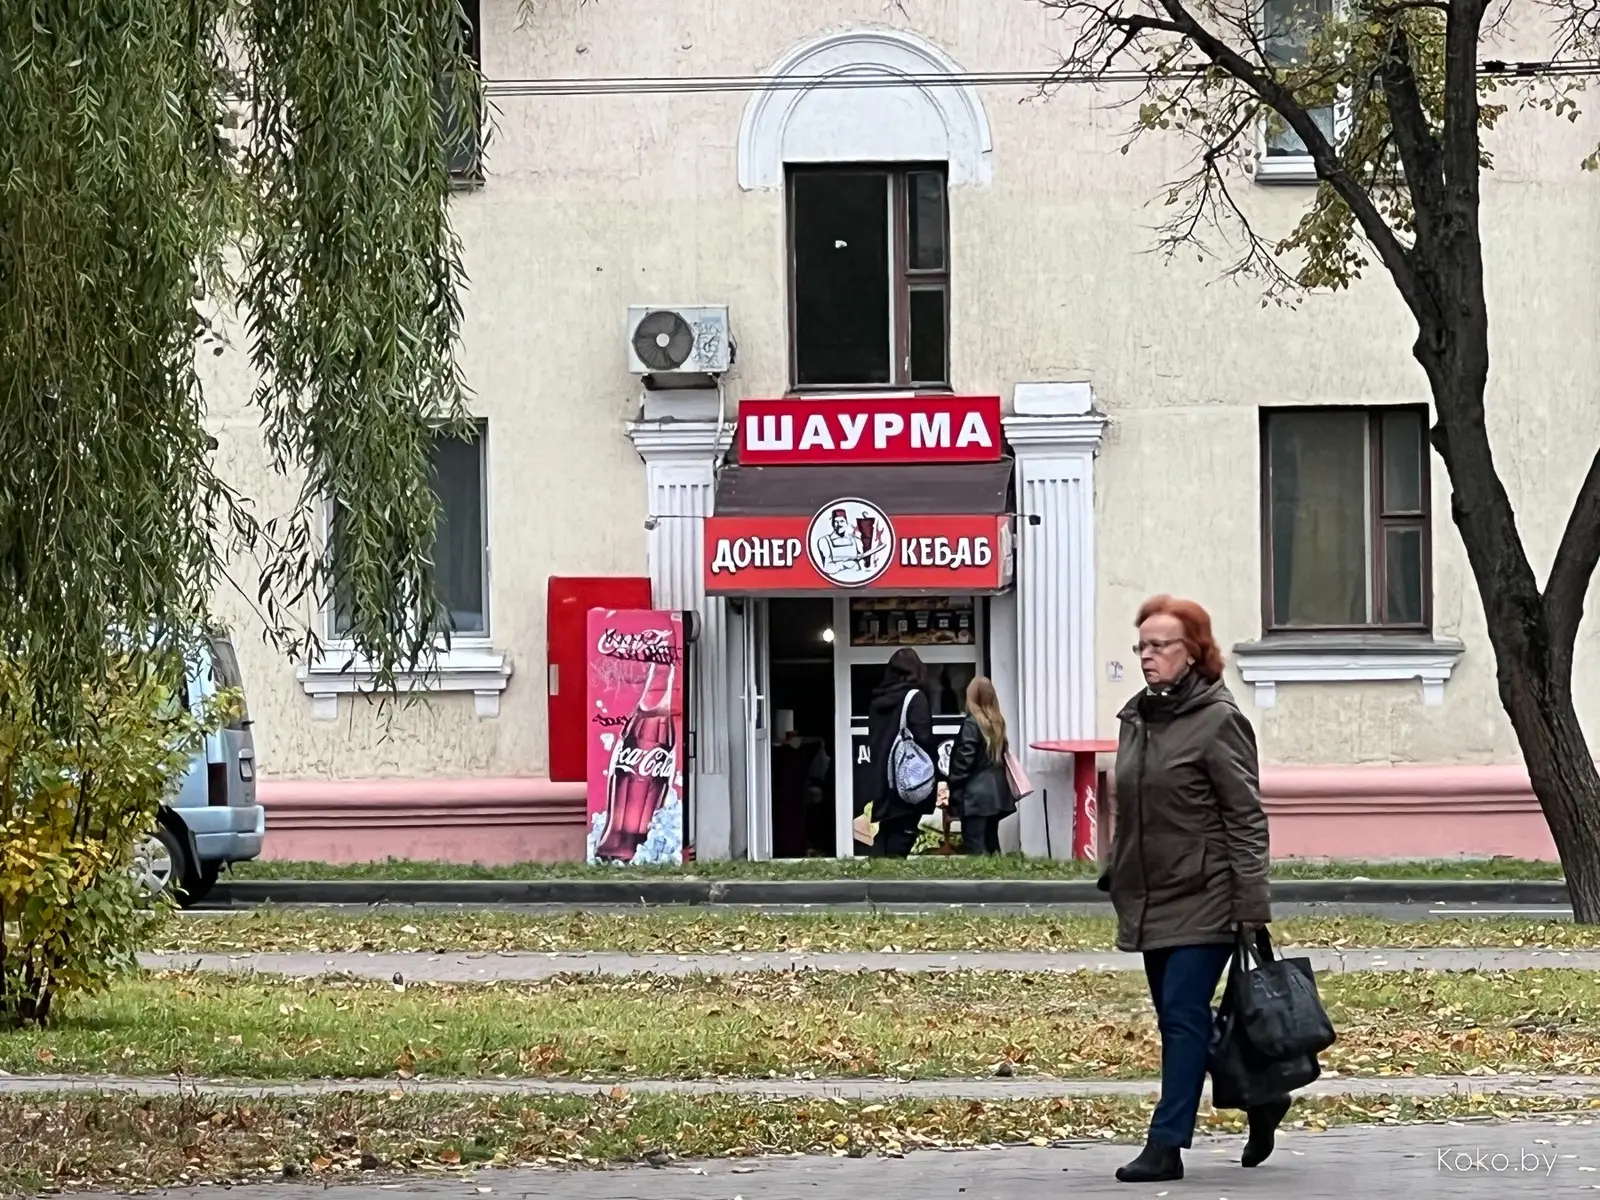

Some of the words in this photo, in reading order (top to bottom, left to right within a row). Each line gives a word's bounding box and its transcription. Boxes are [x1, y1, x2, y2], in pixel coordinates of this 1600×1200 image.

[746, 411, 992, 451] ШАУРМА
[711, 536, 802, 574] ДОНЕР
[901, 536, 992, 569] КЕБАБ
